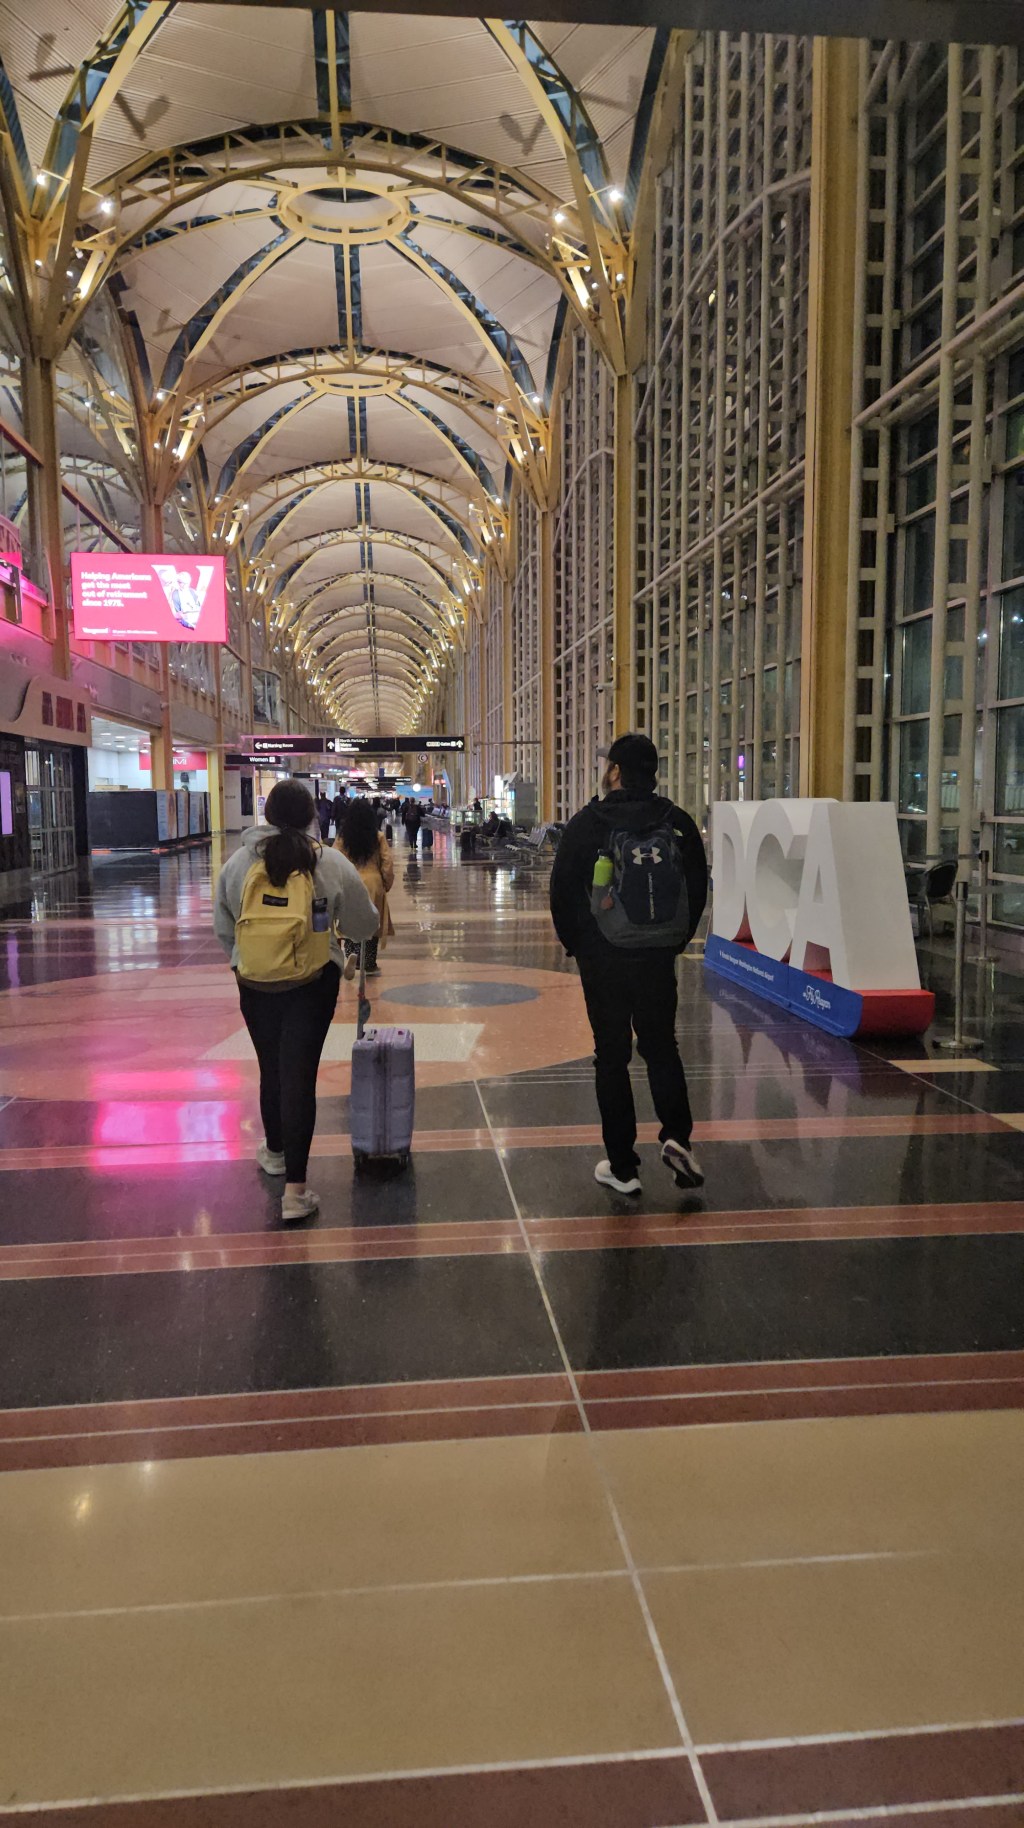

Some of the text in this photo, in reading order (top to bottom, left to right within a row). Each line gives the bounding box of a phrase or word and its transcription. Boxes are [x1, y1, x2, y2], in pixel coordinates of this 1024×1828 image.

[81, 571, 152, 581] Helping Americans
[81, 582, 95, 590] get
[96, 590, 106, 598] of
[106, 591, 148, 599] retirement
[712, 799, 852, 990] DCA
